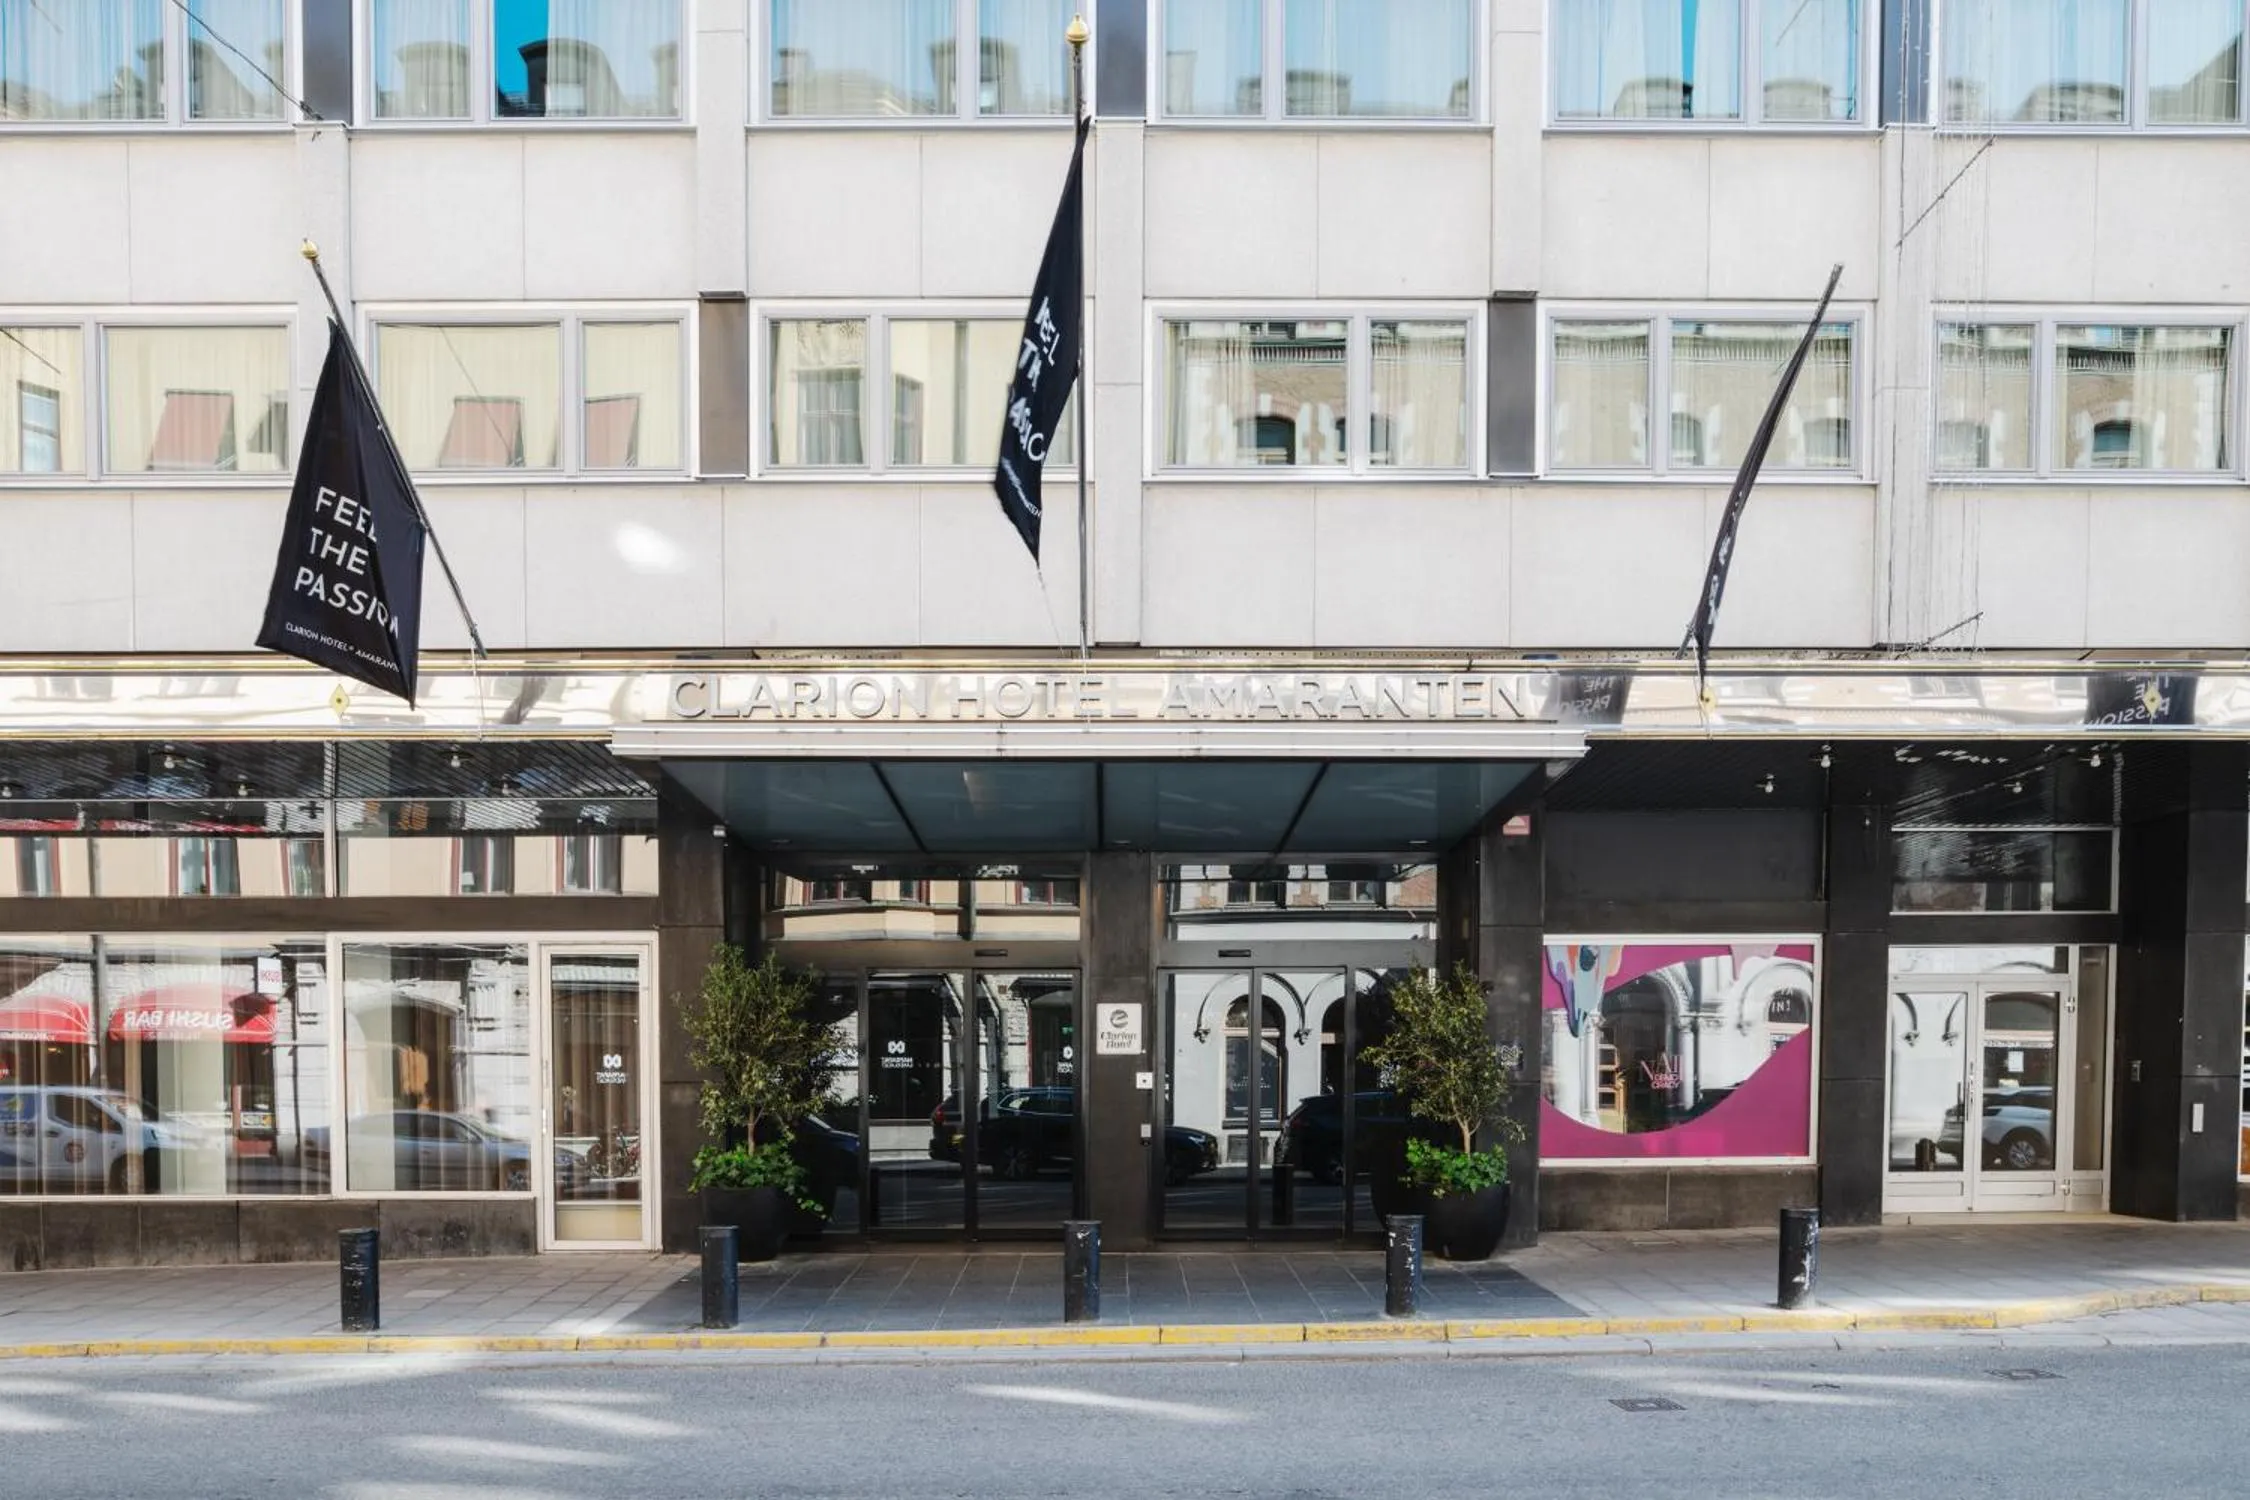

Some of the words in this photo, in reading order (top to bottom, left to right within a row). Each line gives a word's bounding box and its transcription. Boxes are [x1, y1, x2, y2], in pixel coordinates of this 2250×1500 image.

[309, 526, 370, 576] THE
[285, 622, 319, 640] CLARION
[670, 674, 928, 719] CLARION
[950, 674, 1138, 719] HOTEL
[1156, 672, 1526, 719] AMARANTEN
